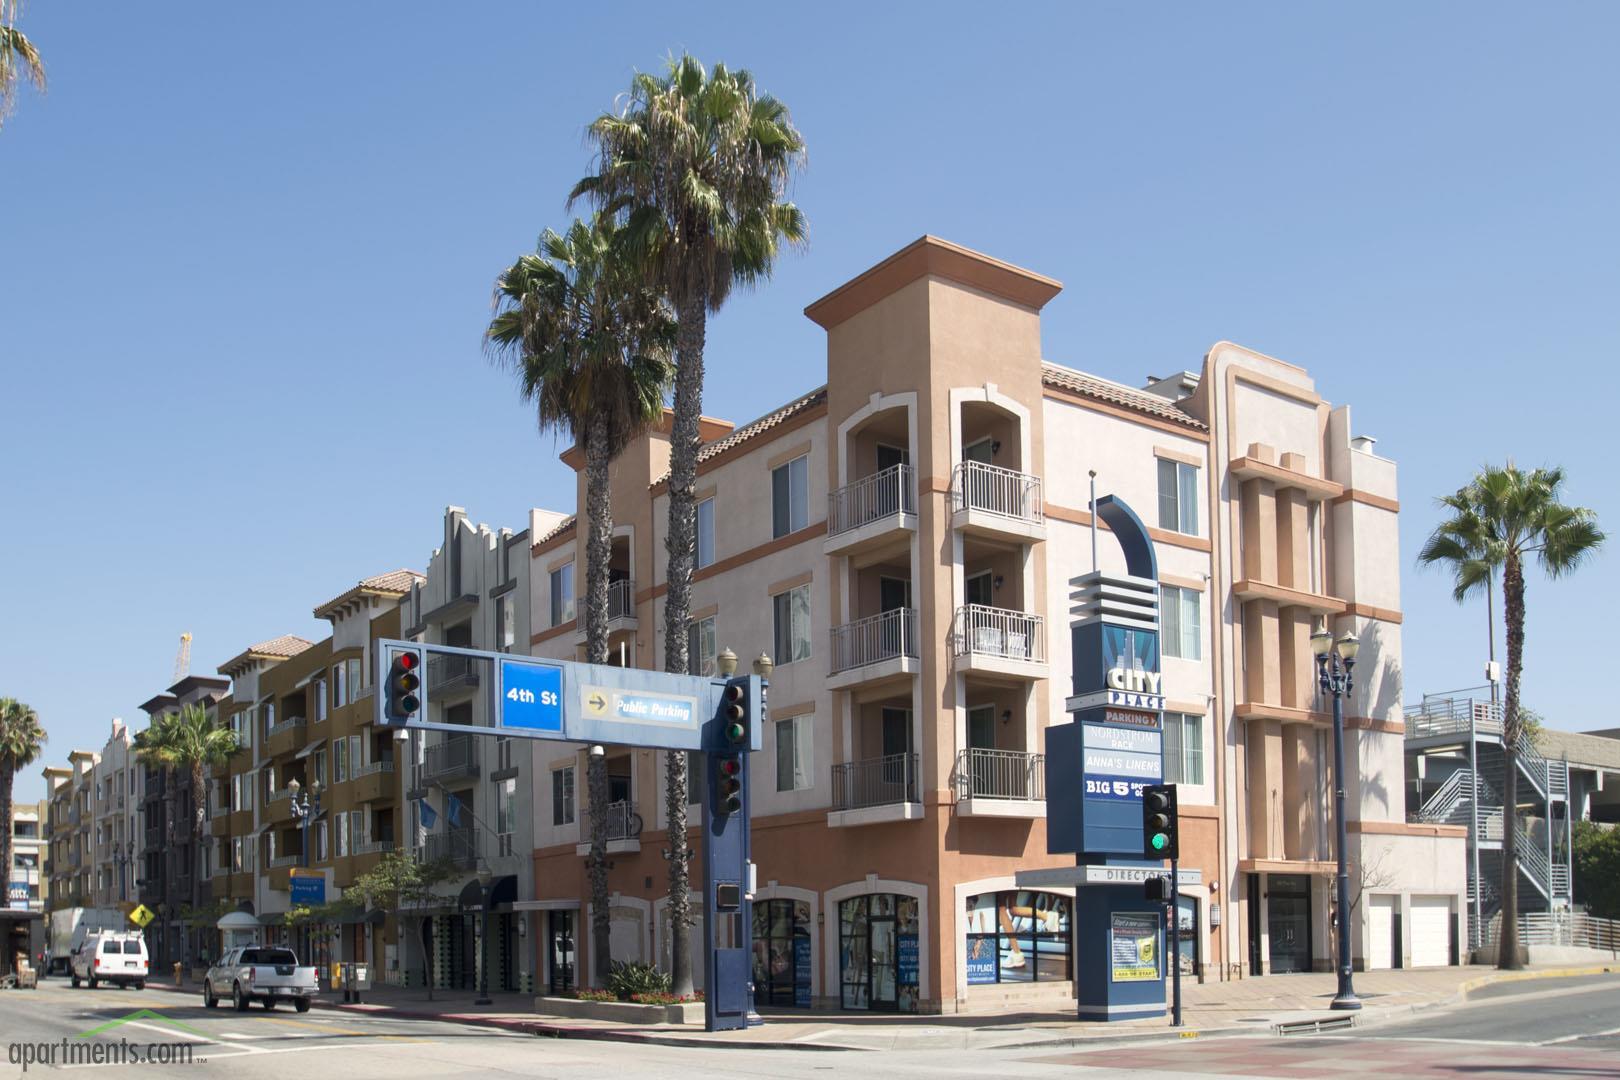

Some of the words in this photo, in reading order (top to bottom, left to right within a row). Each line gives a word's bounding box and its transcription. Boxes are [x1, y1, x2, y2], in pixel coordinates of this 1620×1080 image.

[1107, 668, 1161, 694] CITY
[507, 688, 534, 704] 4th
[541, 691, 558, 706] St
[1112, 691, 1163, 708] PLACE
[616, 699, 648, 715] Public
[651, 703, 690, 721] Parking
[1106, 711, 1150, 724] PARKING
[1091, 727, 1153, 744] NORDSTROM
[1111, 739, 1133, 749] RACK
[1086, 755, 1122, 769] ANNA'S
[1125, 757, 1160, 772] LINENS
[1086, 780, 1111, 794] BIG
[1113, 781, 1129, 796] 5
[1107, 869, 1155, 880] DIRECTO
